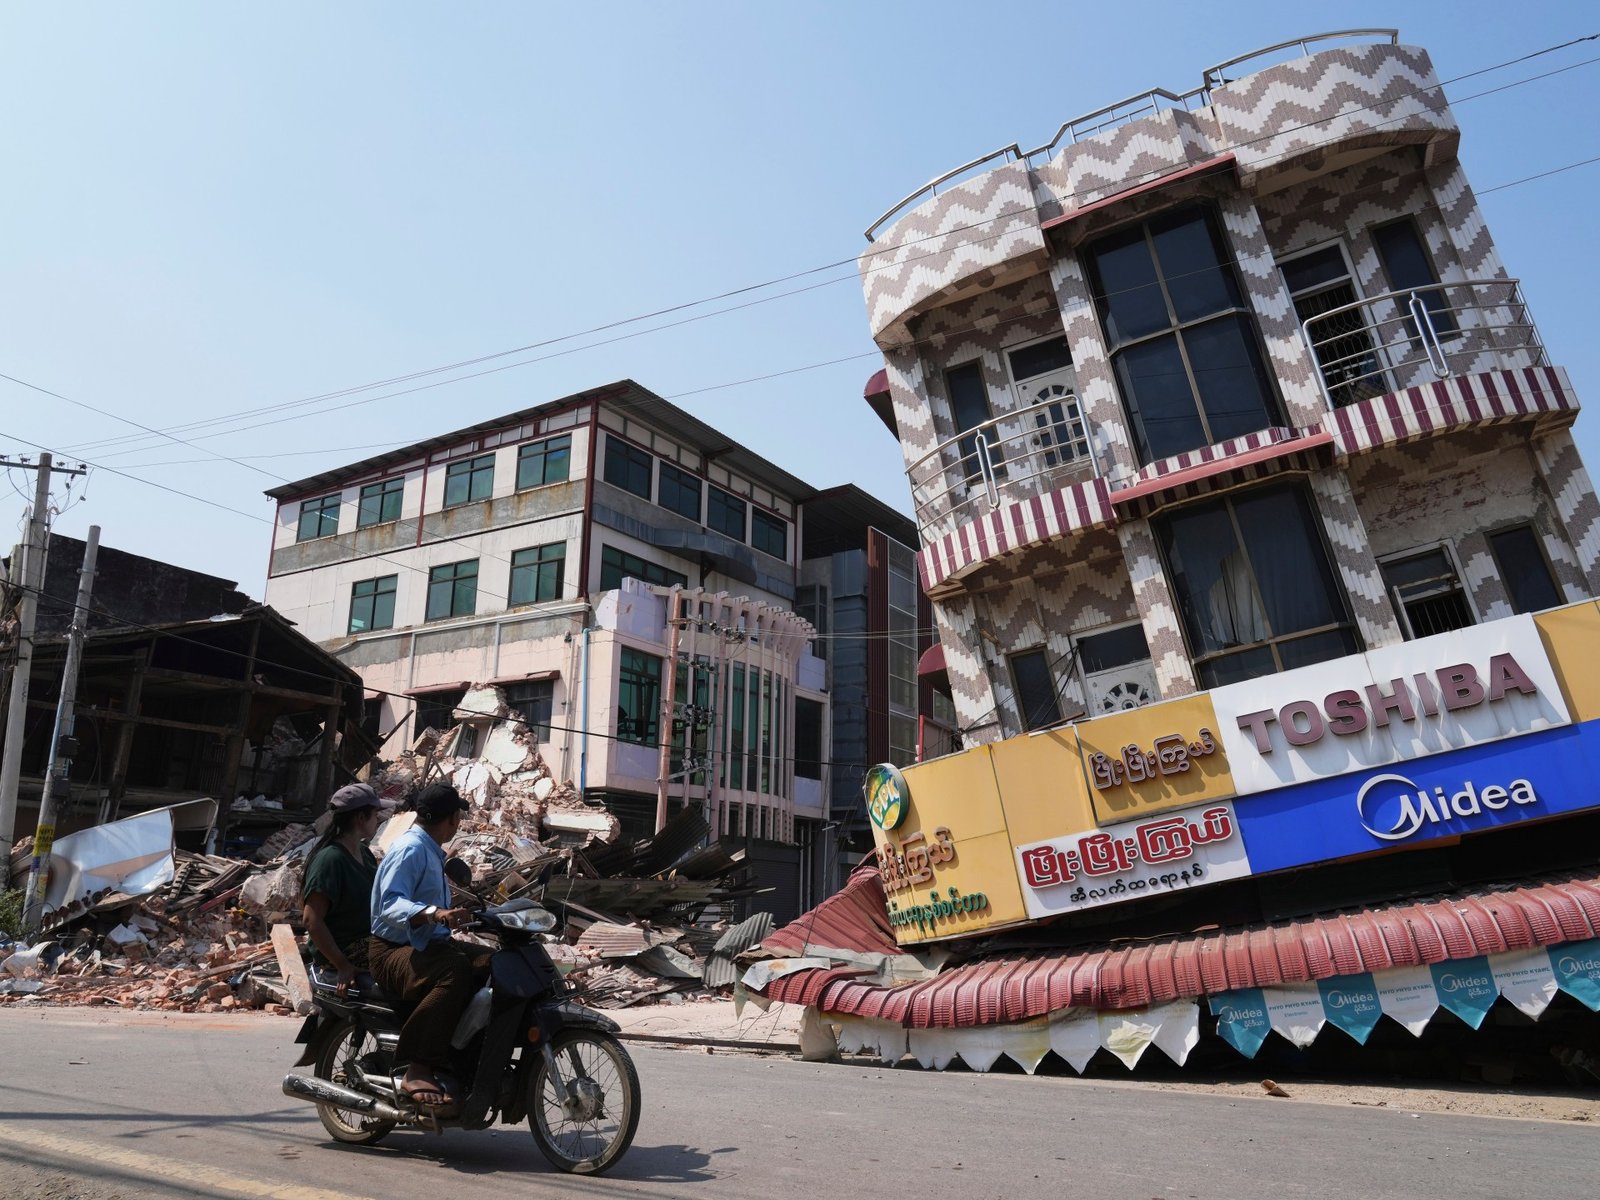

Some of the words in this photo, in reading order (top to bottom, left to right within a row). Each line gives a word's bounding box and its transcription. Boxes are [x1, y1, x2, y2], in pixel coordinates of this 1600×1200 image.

[1236, 652, 1537, 754] TOSHIBA
[1380, 777, 1537, 834] Midea
[1446, 975, 1488, 991] Midea
[1332, 992, 1374, 1007] Midea
[1224, 1007, 1263, 1022] Midea
